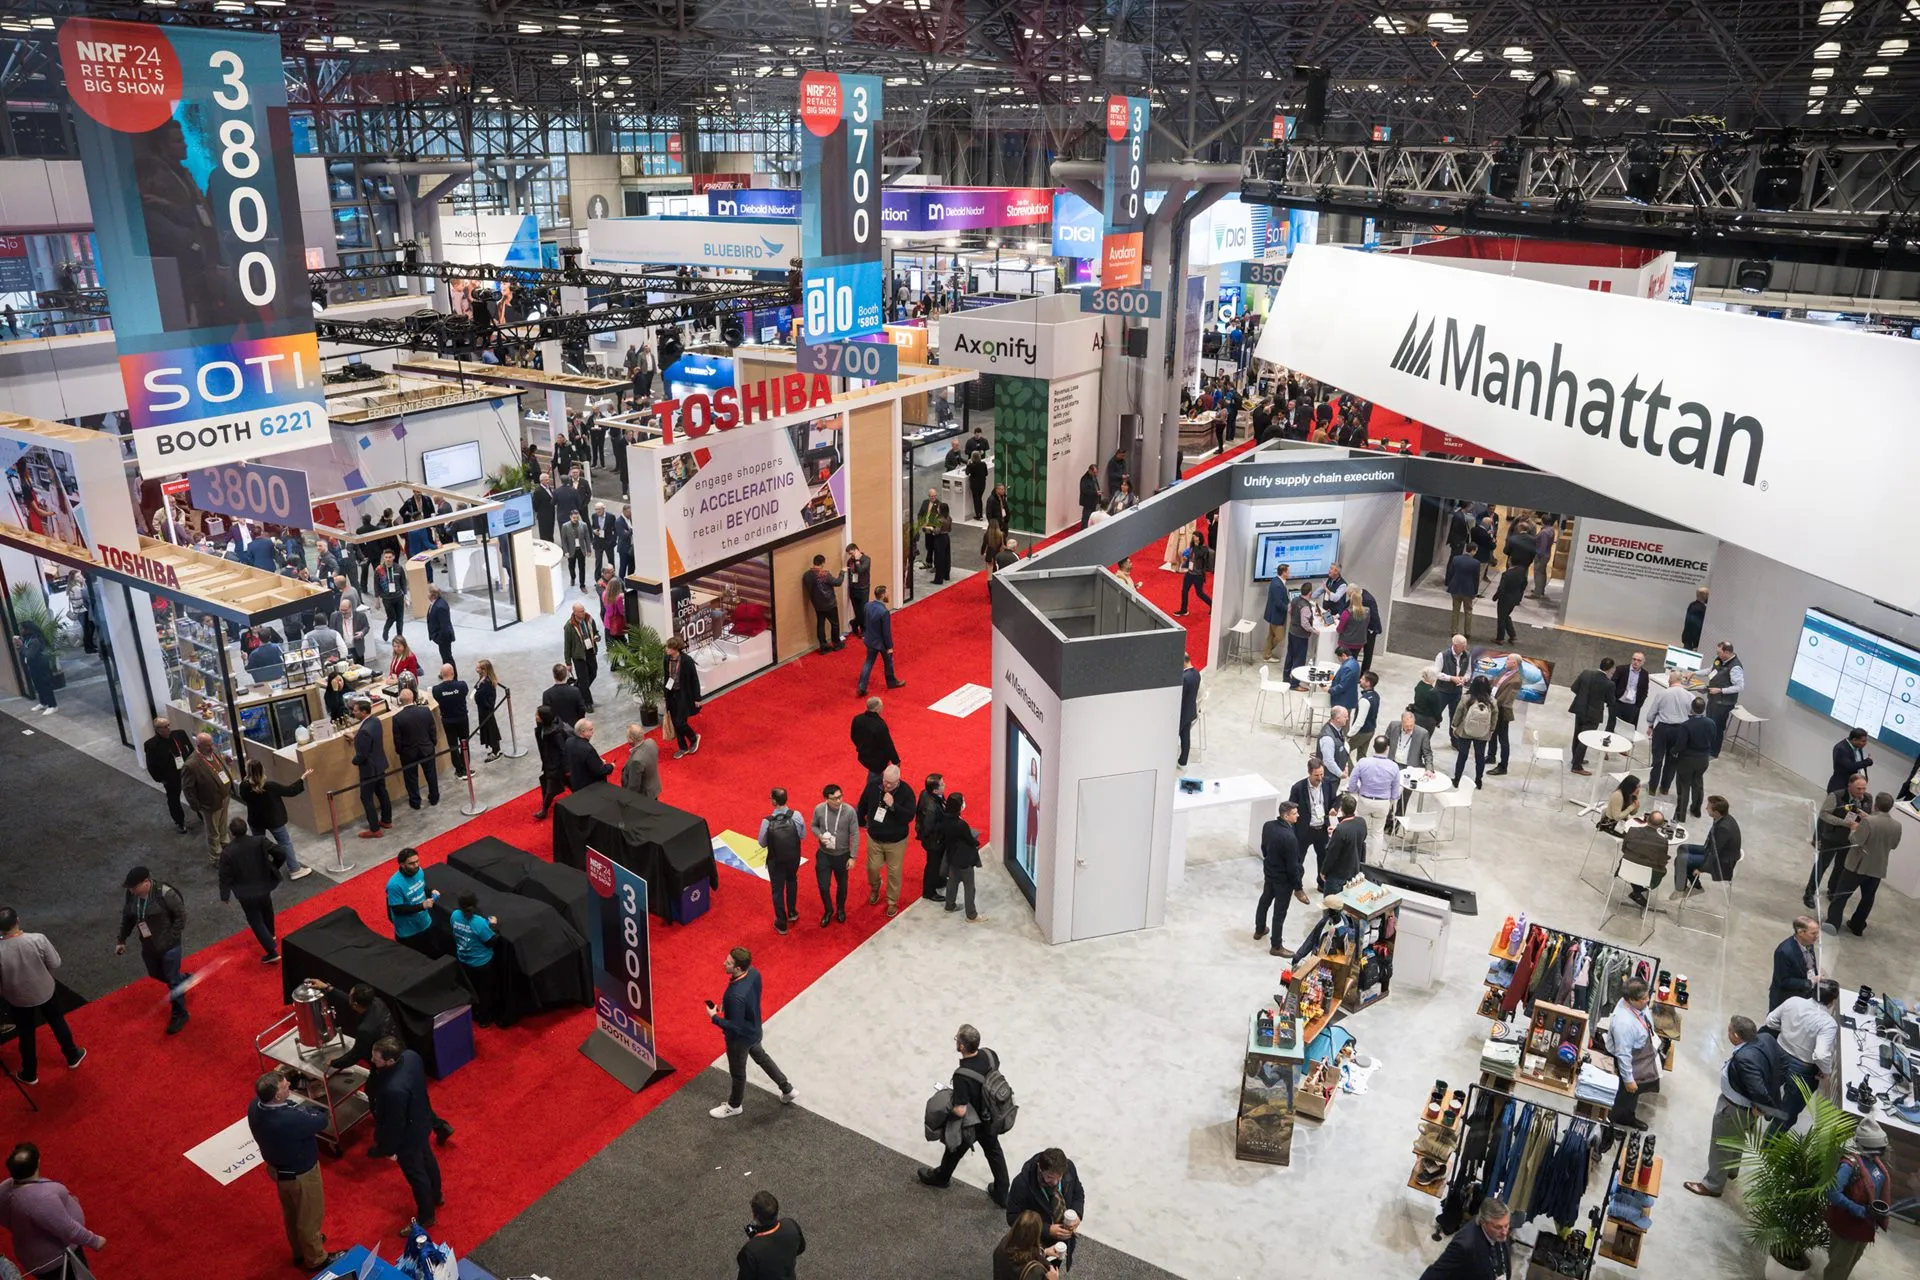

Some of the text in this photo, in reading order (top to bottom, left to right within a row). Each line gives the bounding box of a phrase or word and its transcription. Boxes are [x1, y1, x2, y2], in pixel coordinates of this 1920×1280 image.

[76, 41, 161, 66] NRF'24
[80, 64, 164, 80] RETAIL'S
[84, 79, 164, 95] BIG SHOW
[806, 84, 836, 98] NRF'24
[806, 98, 837, 106] RETAIL'S
[806, 106, 837, 115] BIG SHOW
[740, 203, 767, 214] Diebold
[768, 204, 796, 215] Nixdorf
[946, 206, 966, 217] Diebold
[966, 205, 985, 216] Nixdorf
[455, 230, 487, 238] Modern
[1109, 244, 1136, 260] Avalara
[1250, 265, 1285, 285] 350
[858, 303, 879, 316] Booth
[1093, 290, 1149, 314] 3600
[812, 344, 880, 376] 3700
[955, 333, 1037, 365] Axonify
[144, 351, 305, 412] SOTI
[368, 391, 489, 418] FRICTIONLESS EXPERIENCE
[651, 372, 832, 445] TOSHIBA
[1440, 316, 1764, 487] Manhattan
[156, 410, 312, 456] BOOTH 6221
[696, 457, 783, 490] engage shoppers
[1244, 470, 1395, 488] Unify supply chain execution
[204, 466, 290, 518] 3800
[683, 472, 794, 518] by ACCELERATING
[693, 500, 779, 539] retail BEYOND
[722, 519, 788, 550] the ordinary
[1588, 534, 1664, 553] EXPERIENCE
[97, 544, 180, 590] TOSHIBA
[1586, 544, 1634, 560] UNIFIED
[1636, 552, 1709, 572] COMMERCE
[1012, 672, 1044, 724] Manhattan
[599, 996, 648, 1044] SOTI
[602, 1020, 650, 1061] BOOTH 6221
[222, 1153, 256, 1174] DATA
